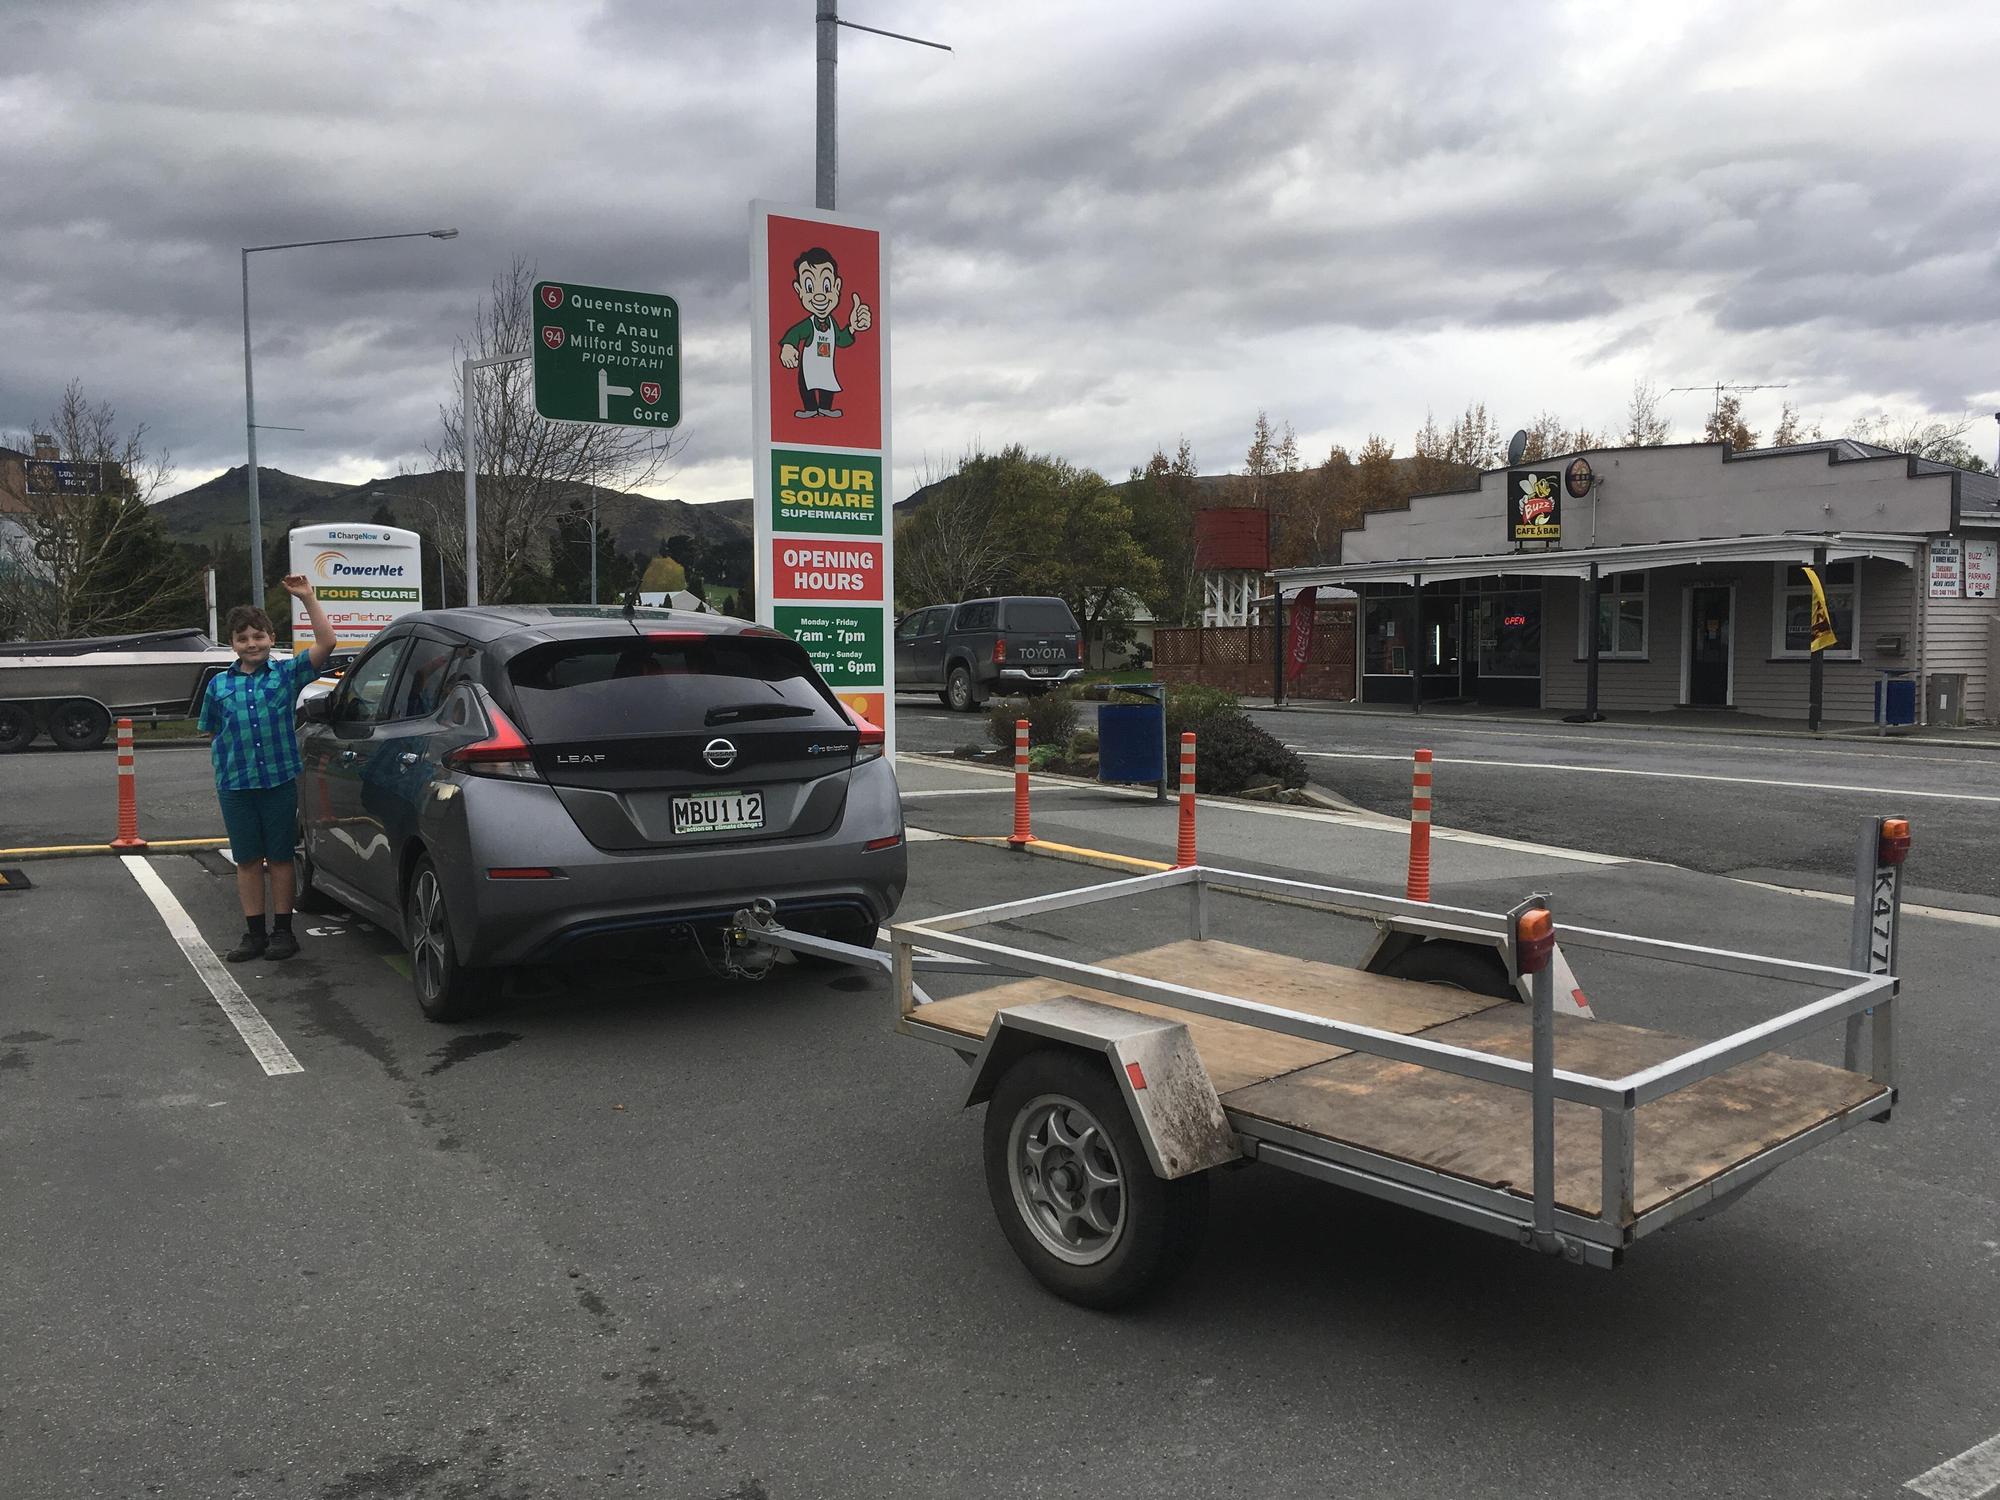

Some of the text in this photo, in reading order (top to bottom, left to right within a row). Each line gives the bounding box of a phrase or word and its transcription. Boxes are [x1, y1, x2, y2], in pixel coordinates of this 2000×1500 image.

[548, 291, 557, 303] 6
[571, 294, 672, 318] Queenstown
[586, 319, 659, 339] Te Anau
[546, 330, 561, 344] 94
[570, 334, 674, 357] Milford Sound
[582, 352, 664, 370] PIOPIOTAHI
[643, 386, 658, 399] 94
[633, 407, 669, 422] Gore
[780, 465, 874, 491] FOUR
[780, 489, 875, 509] SQUARE
[781, 508, 875, 522] SUPERMARKET
[337, 531, 378, 541] ChargeNow
[1516, 527, 1559, 536] CAFE & BAR
[783, 549, 874, 570] OPENING
[1968, 552, 1983, 560] BUZZ
[333, 563, 404, 577] PowerNet
[1968, 562, 1981, 570] BIKE
[794, 572, 864, 590] HOURS
[1968, 572, 1991, 581] PARKING
[1968, 582, 1990, 590] AT REAR
[319, 589, 417, 599] FOUR SQUARE
[300, 612, 393, 624] CrgeNet.nz
[801, 618, 829, 627] Monday
[836, 618, 859, 627] Friday
[1504, 616, 1526, 626] OPEN
[794, 629, 823, 642] 7am
[836, 629, 865, 644] 7pm
[836, 650, 863, 660] Sunday
[1019, 647, 1066, 659] TOYOTA
[847, 660, 876, 675] 6pm
[556, 754, 606, 763] LEAF
[674, 797, 761, 825] MBU112
